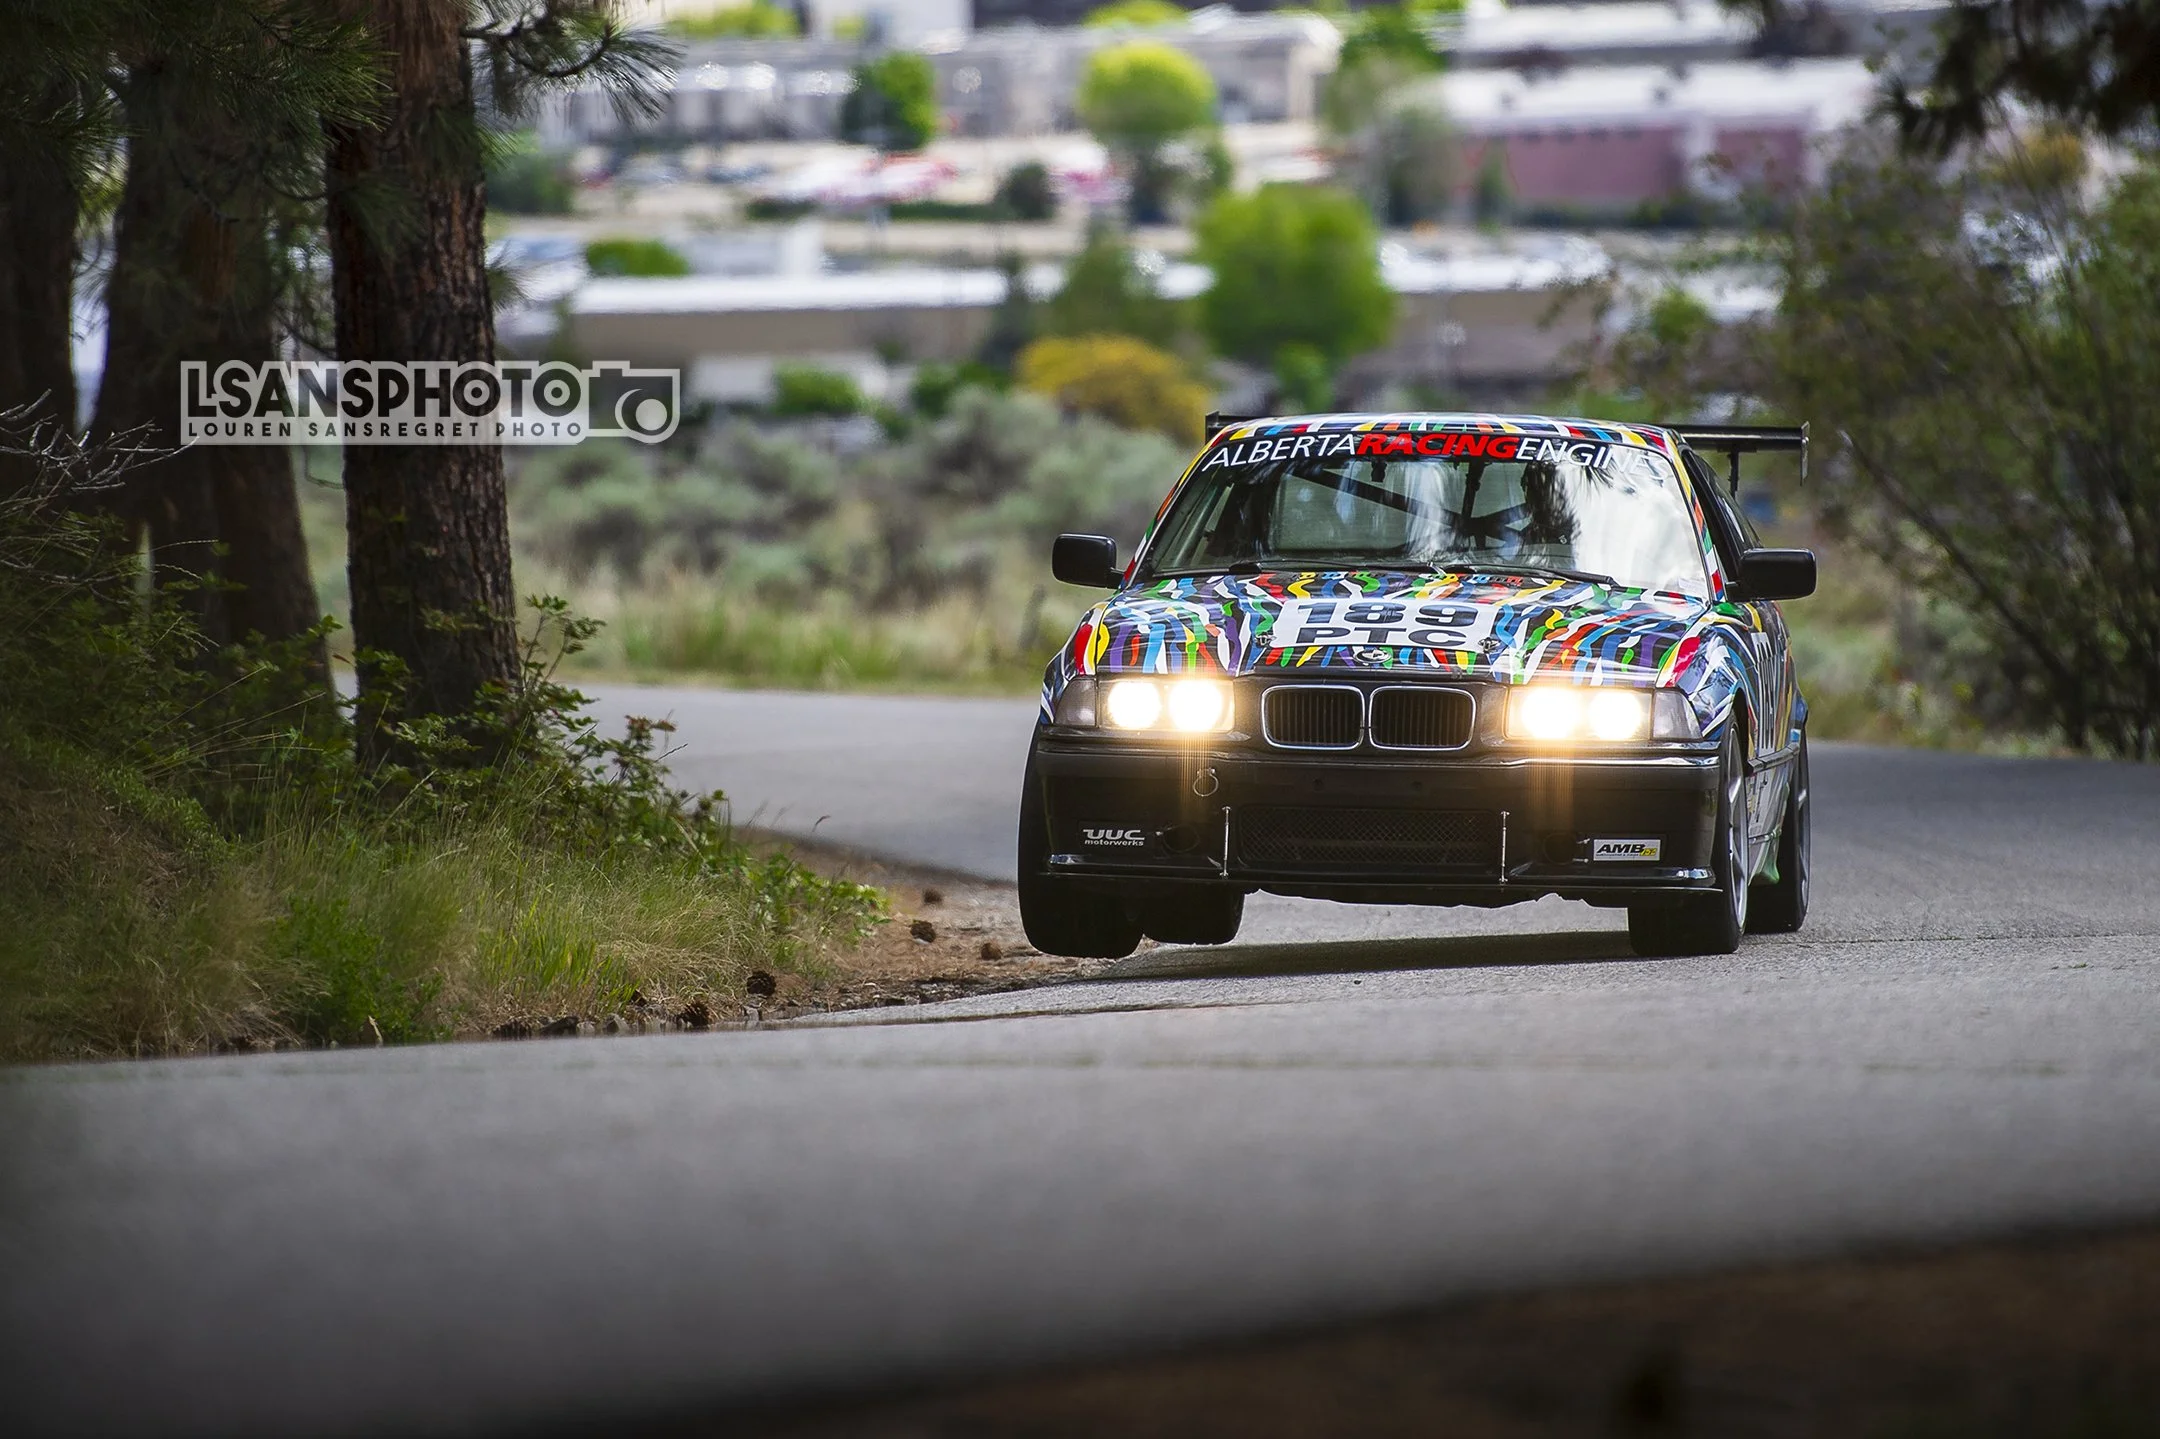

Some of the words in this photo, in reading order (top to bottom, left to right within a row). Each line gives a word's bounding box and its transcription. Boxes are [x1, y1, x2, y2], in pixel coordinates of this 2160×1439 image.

[1201, 433, 1357, 472] ALBERTA
[1356, 433, 1520, 459] RACING
[1297, 602, 1479, 627] 189
[1295, 627, 1467, 647] PTC
[1084, 839, 1144, 847] motorworks
[1596, 844, 1646, 854] AMB
